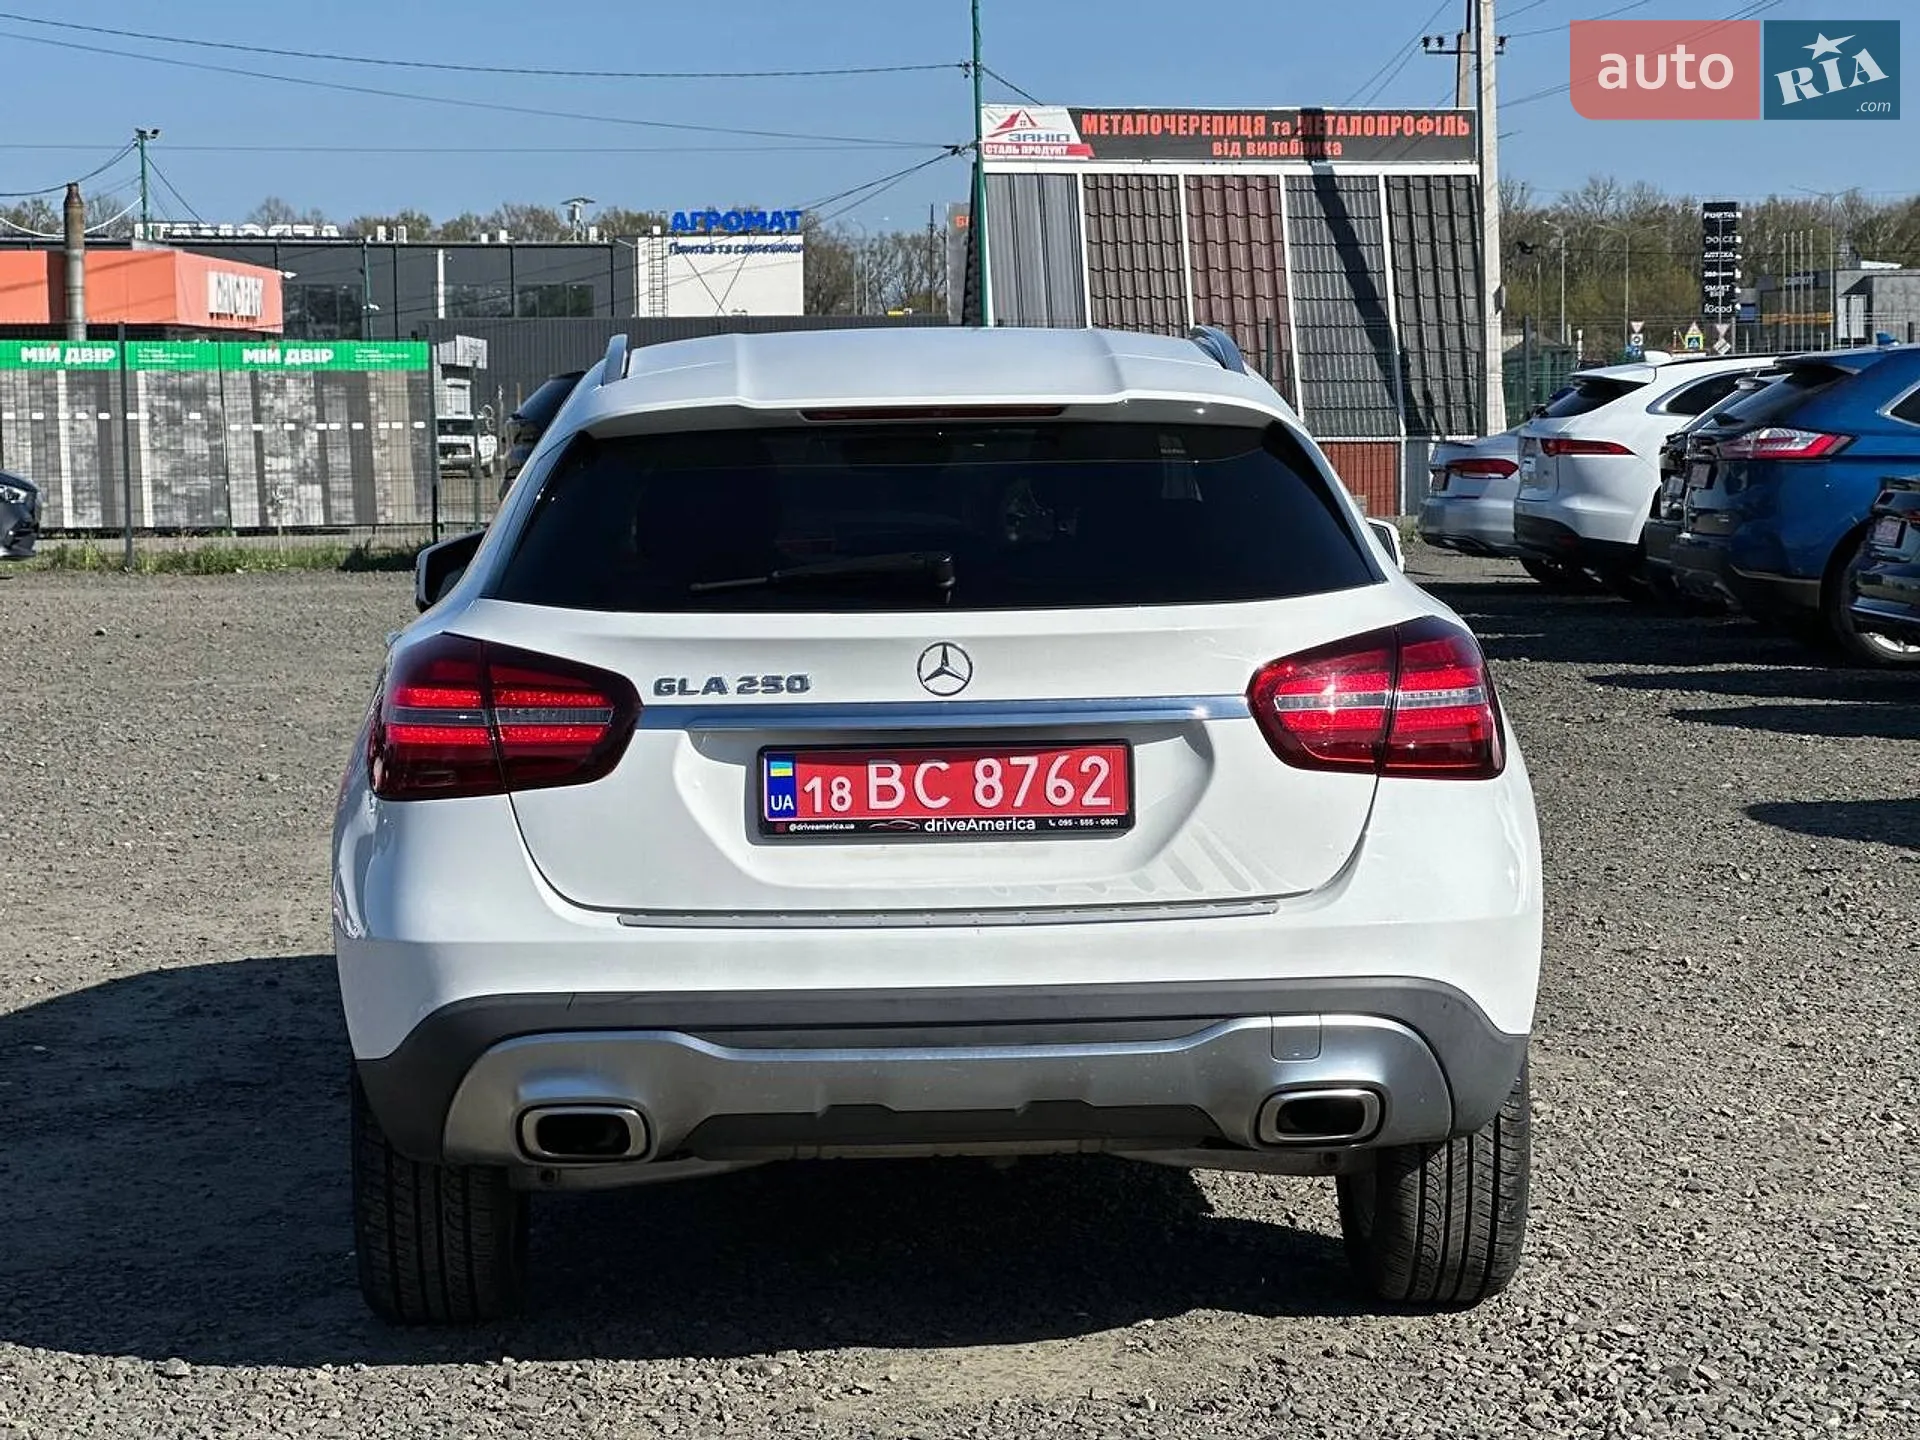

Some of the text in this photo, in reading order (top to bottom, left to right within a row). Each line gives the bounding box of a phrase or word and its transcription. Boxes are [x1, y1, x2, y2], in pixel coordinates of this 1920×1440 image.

[1081, 113, 1471, 138] МЕТАЛОЧЕРЕПИЦЯ та МЕТАЛОПРОФІЛЬ
[985, 144, 1020, 156] СТАЛЬ
[1212, 138, 1242, 158] від
[671, 210, 803, 231] АГРОМАТ
[20, 346, 61, 364] МІЙ
[64, 347, 116, 365] ДВІР
[242, 347, 282, 365] МІЙ
[284, 348, 334, 366] ДВІР
[652, 673, 811, 697] GLA 250
[803, 755, 1112, 814] 18 BC 8762
[770, 795, 795, 811] UA
[789, 822, 855, 832] @driveamerica.ua
[925, 817, 1036, 833] driveAmerica
